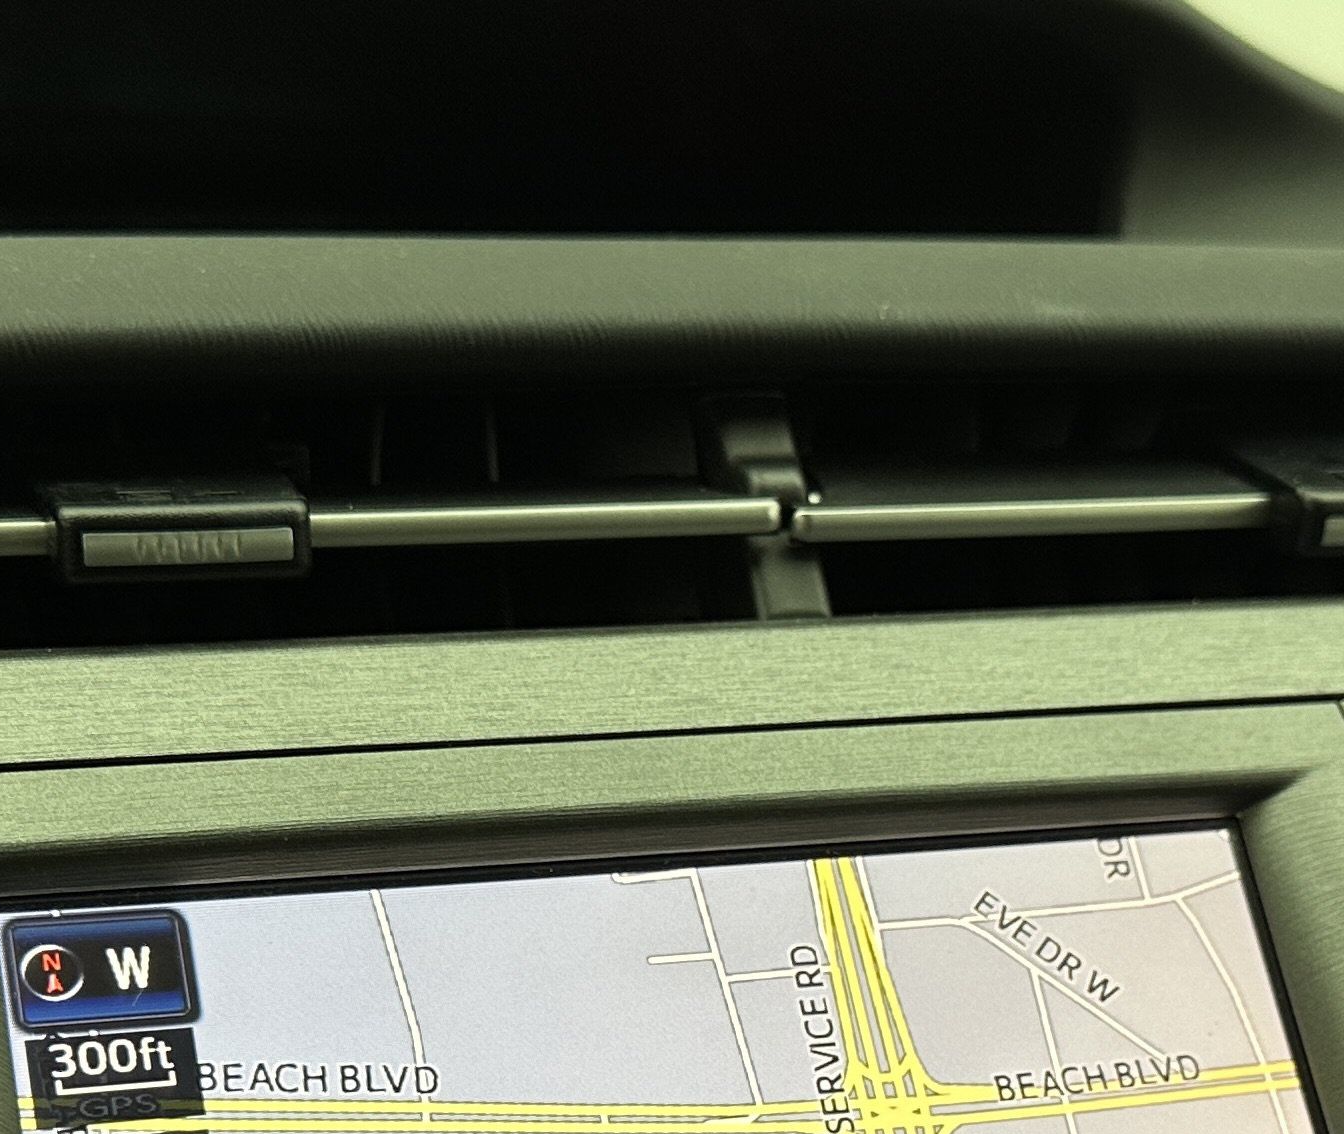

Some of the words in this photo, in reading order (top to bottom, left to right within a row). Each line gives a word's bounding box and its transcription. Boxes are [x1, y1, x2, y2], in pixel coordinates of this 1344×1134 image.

[105, 944, 151, 990] W
[790, 945, 826, 989] RD
[973, 890, 1033, 944] EVE
[1034, 937, 1091, 980] DR
[1086, 969, 1121, 1002] W
[48, 1036, 175, 1079] 300ft
[198, 1062, 328, 1094] BEACH
[340, 1064, 440, 1095] BLVD
[993, 1065, 1107, 1102] BEACH
[1119, 1053, 1201, 1090] BLVD
[79, 1092, 157, 1119] GPS
